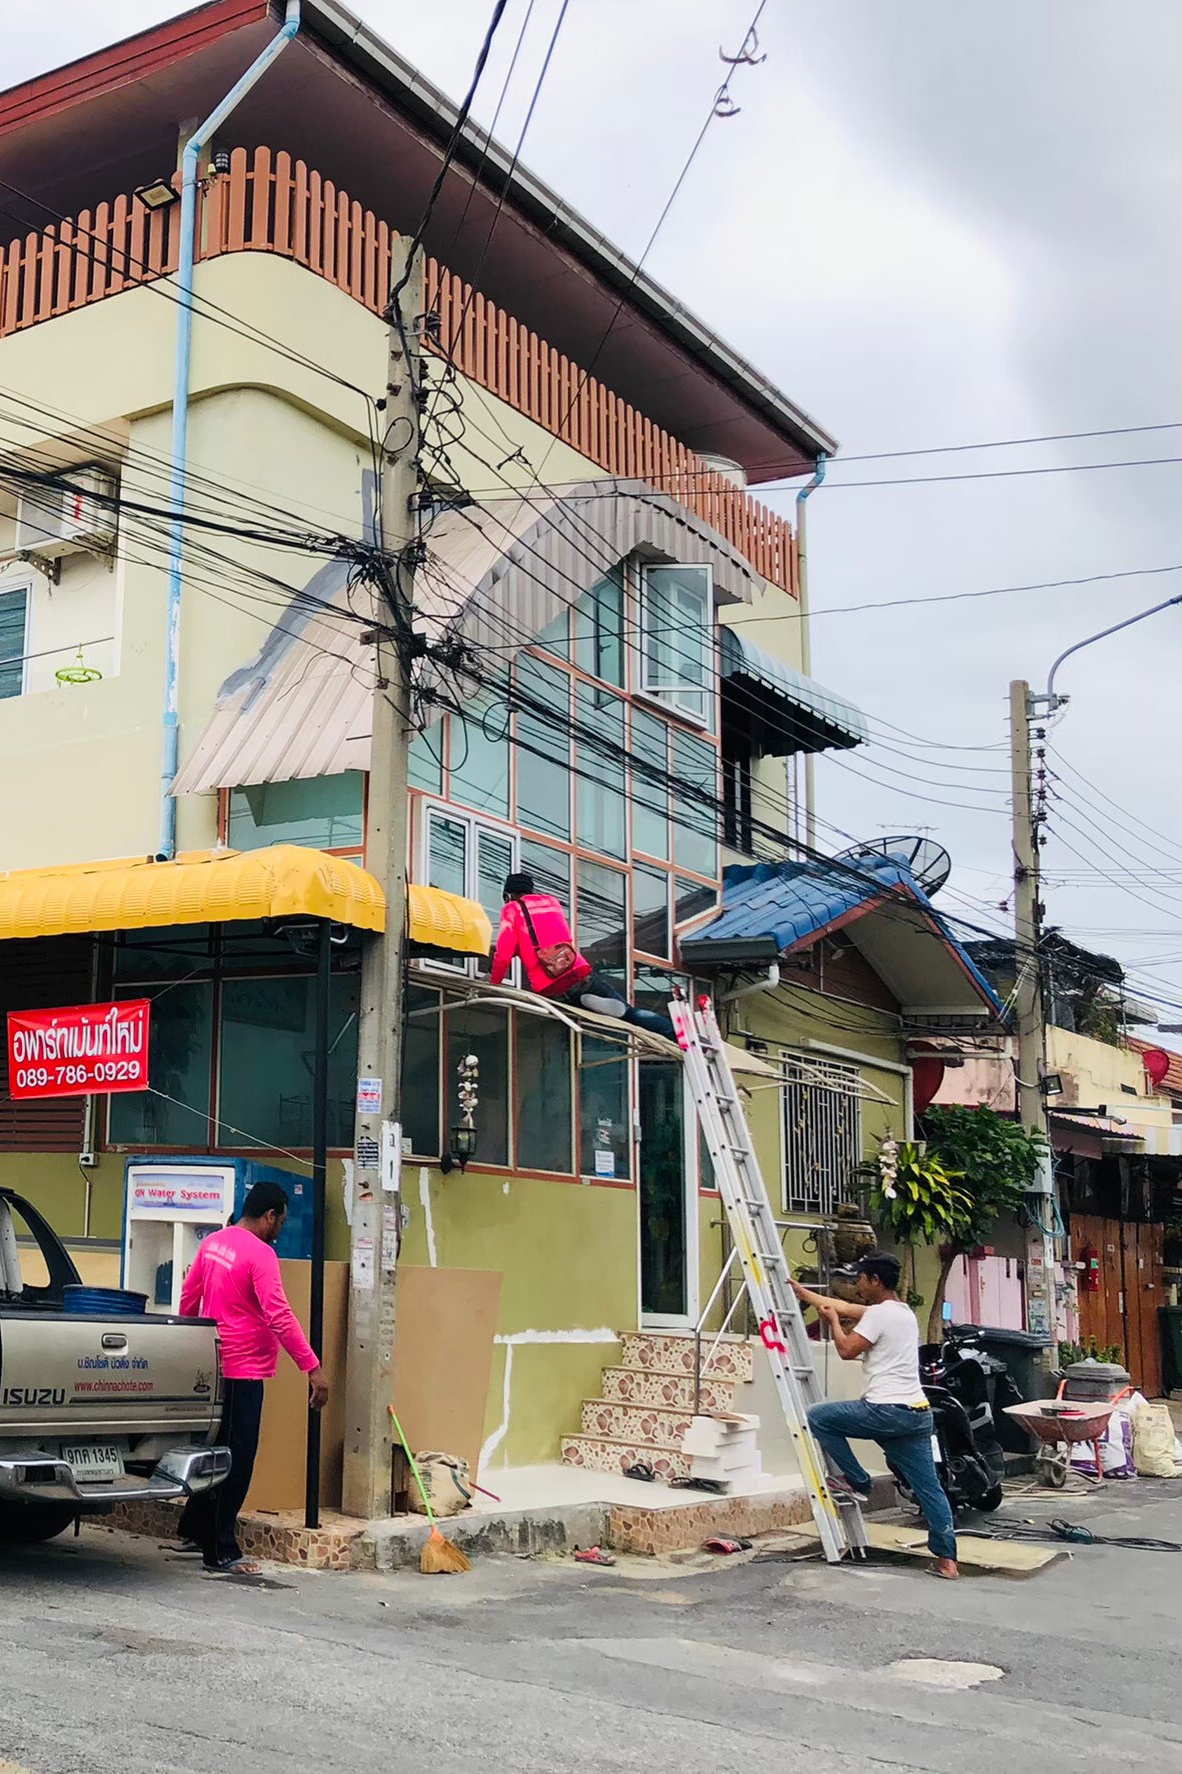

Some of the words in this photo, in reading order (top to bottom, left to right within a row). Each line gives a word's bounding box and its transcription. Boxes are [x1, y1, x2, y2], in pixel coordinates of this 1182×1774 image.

[16, 1060, 140, 1088] 089-786-0929
[148, 1188, 176, 1198] Water
[180, 1190, 220, 1200] System
[74, 1380, 154, 1392] www.chinnachote.com
[3, 1388, 66, 1405] ISUZU
[92, 1447, 118, 1463] 1345
